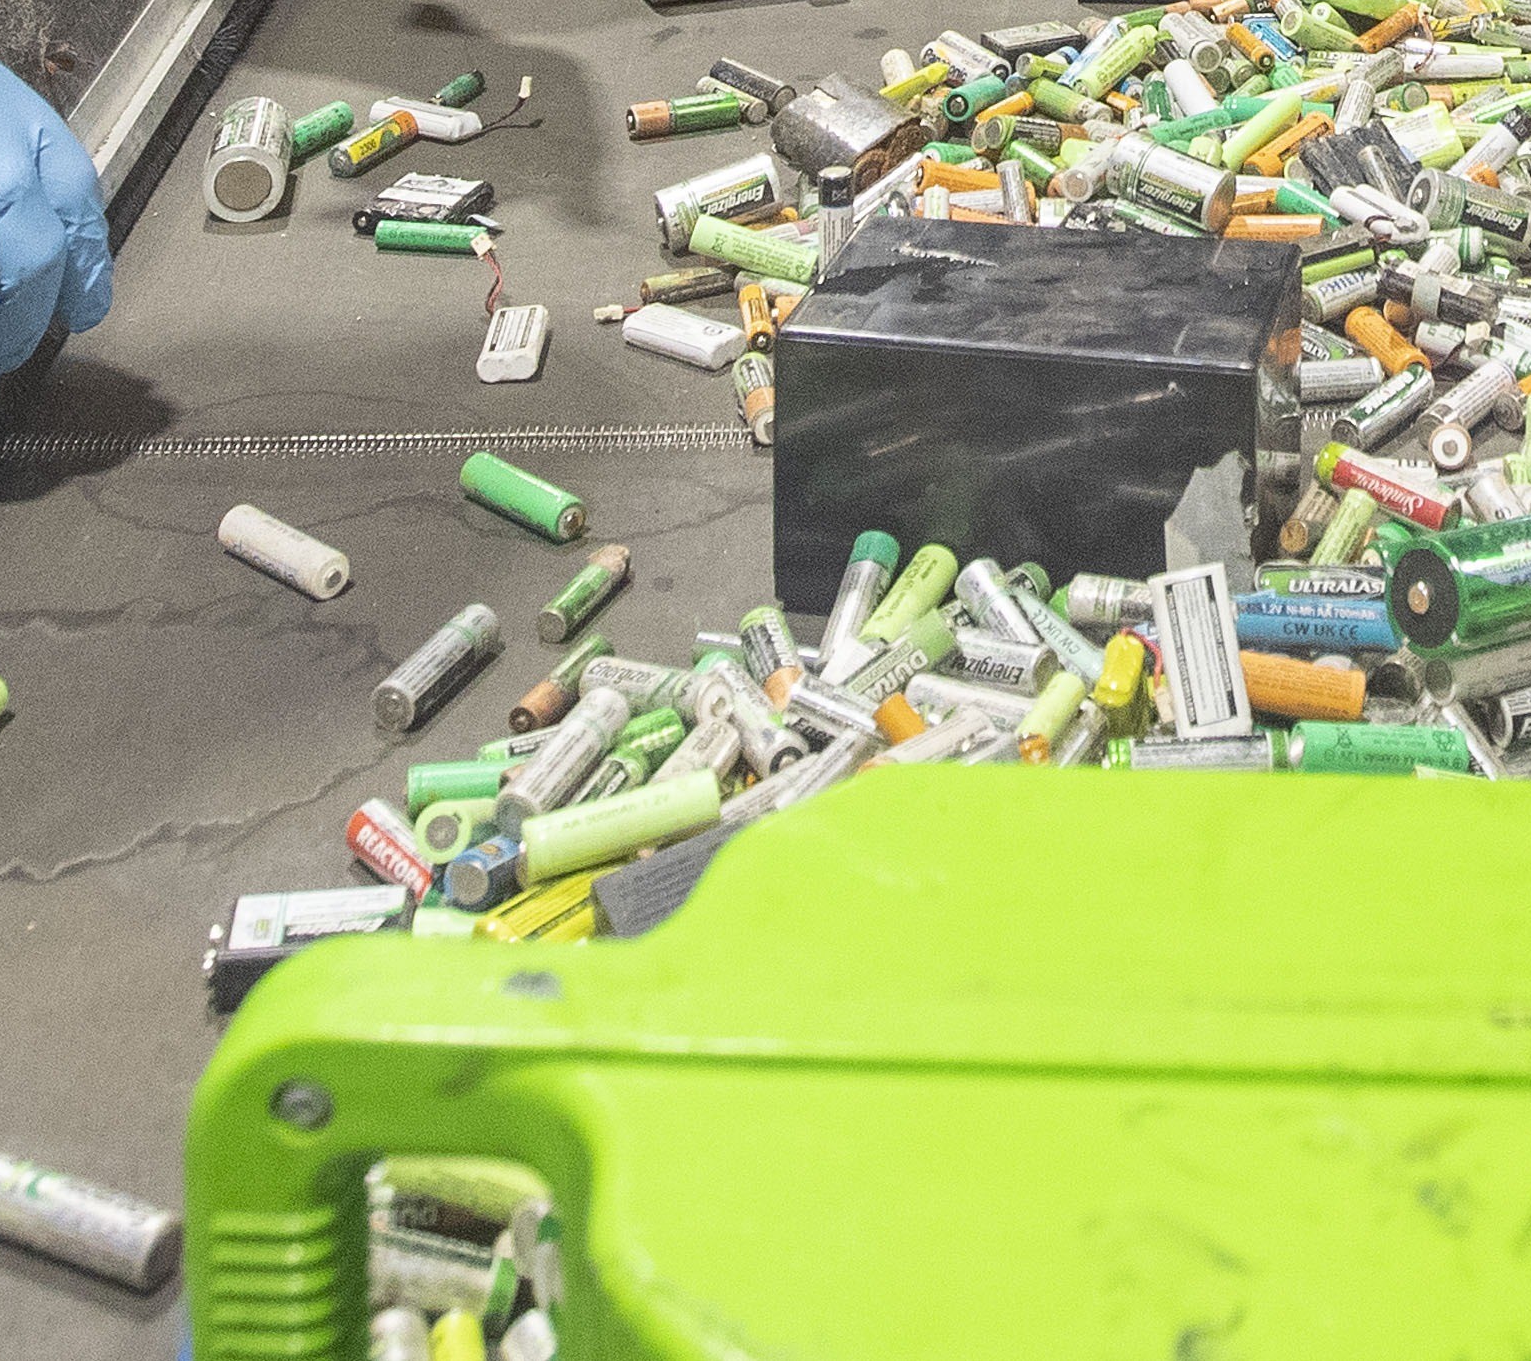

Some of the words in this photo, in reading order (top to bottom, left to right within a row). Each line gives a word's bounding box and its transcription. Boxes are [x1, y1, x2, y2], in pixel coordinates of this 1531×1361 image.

[706, 183, 766, 217] Energizer
[1139, 184, 1197, 214] Energizer
[1465, 202, 1520, 231] Energizer
[1318, 271, 1366, 297] PHILIP
[1313, 624, 1337, 637] UK
[864, 649, 929, 705] DURA
[950, 655, 1025, 686] Energizer
